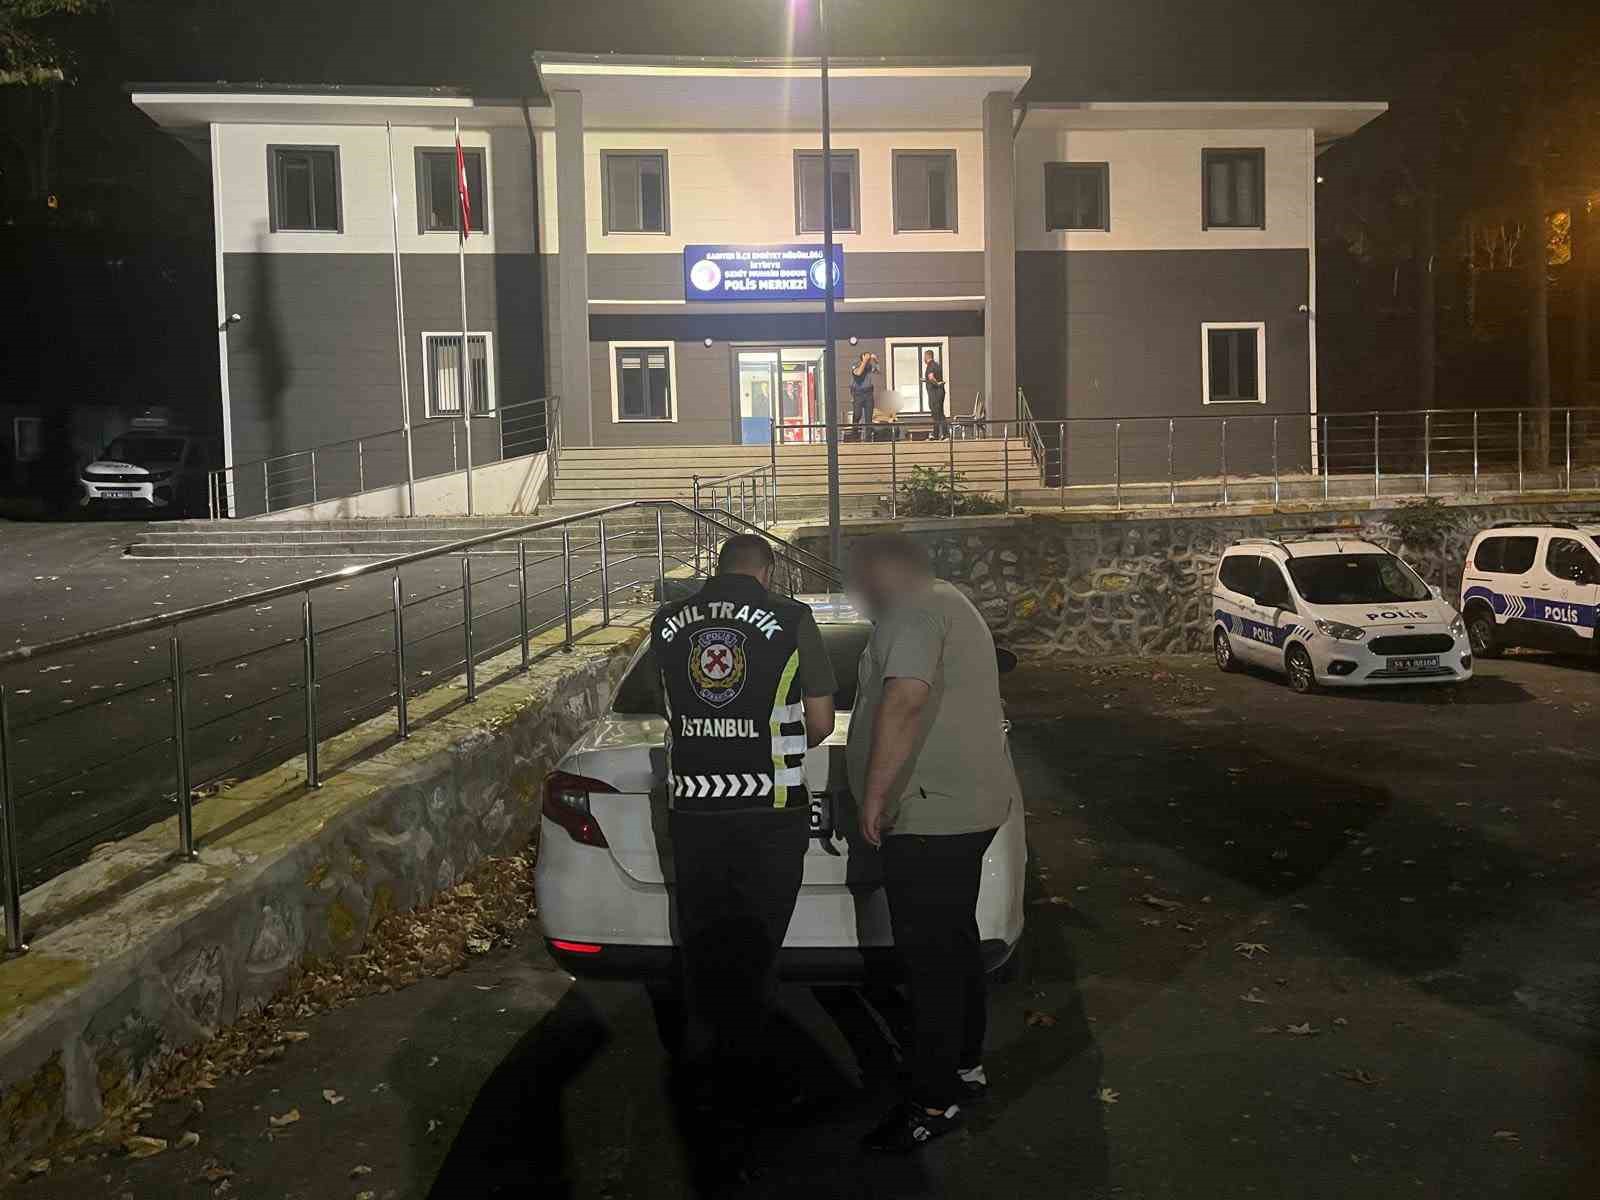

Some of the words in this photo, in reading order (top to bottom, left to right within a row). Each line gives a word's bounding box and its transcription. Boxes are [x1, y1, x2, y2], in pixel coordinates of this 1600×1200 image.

[725, 278, 757, 290] POLİS
[759, 278, 807, 290] MERKEZİ
[661, 604, 705, 643] SİVİL
[707, 601, 783, 640] TRAFİK
[1366, 609, 1428, 621] POLİS
[1544, 605, 1578, 624] POLİS
[1253, 626, 1274, 643] POLİS
[680, 714, 759, 739] İSTANBUL
